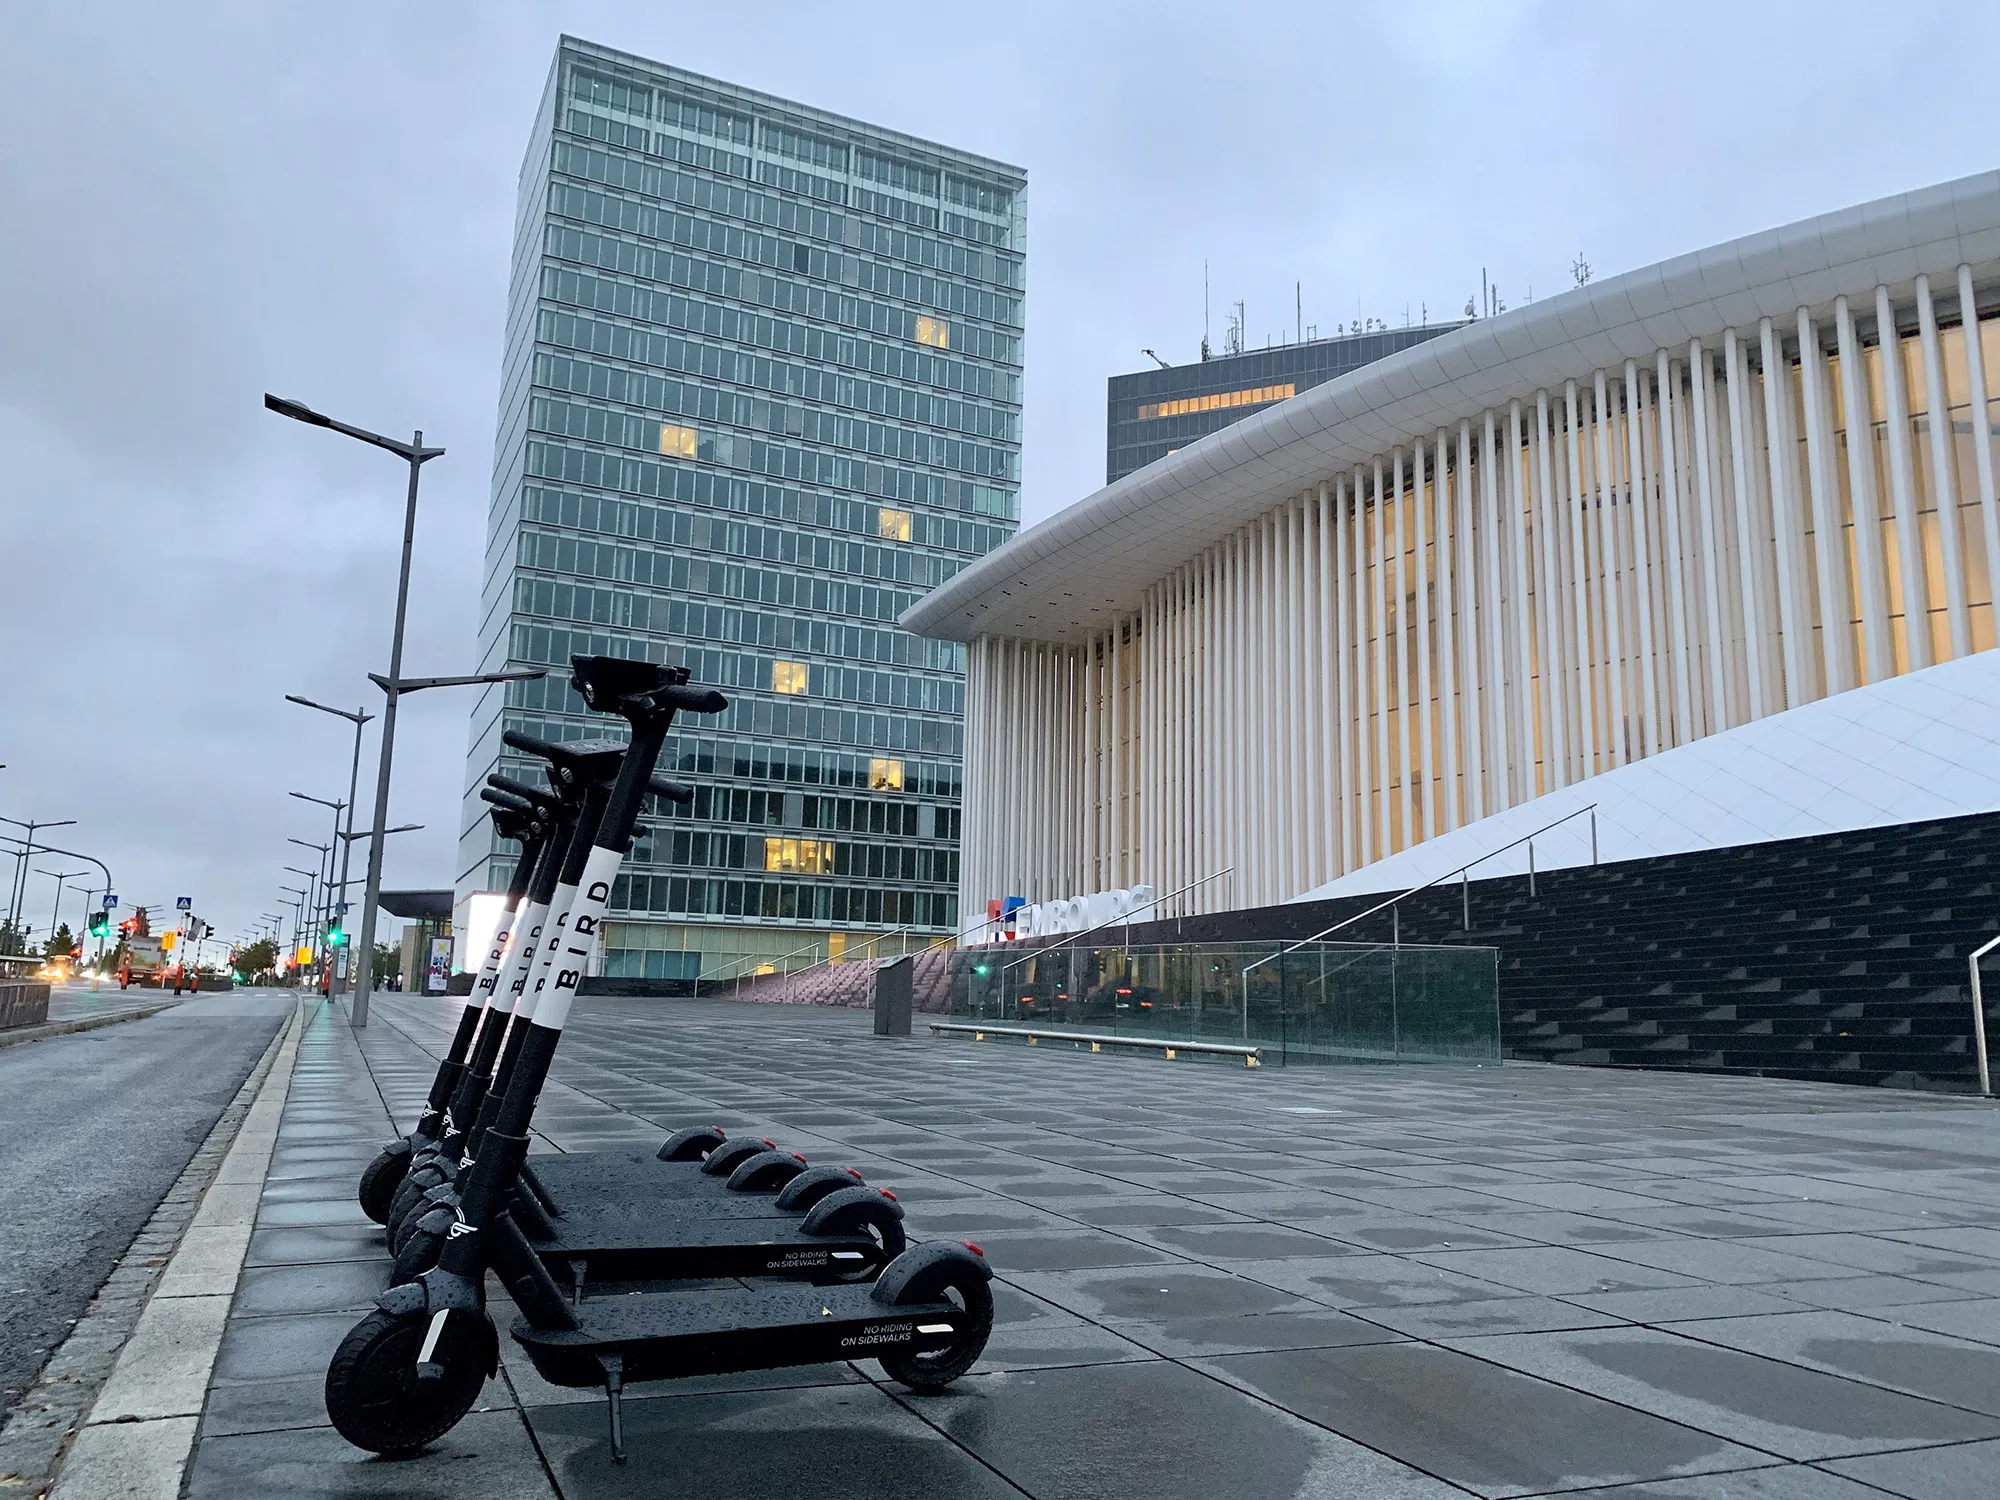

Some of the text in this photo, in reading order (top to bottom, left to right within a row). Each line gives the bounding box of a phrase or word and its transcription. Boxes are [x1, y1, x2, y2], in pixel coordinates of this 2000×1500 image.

[555, 881, 610, 990] BIRD
[478, 930, 509, 989] BIRD
[510, 925, 542, 993] BIRD
[785, 1250, 828, 1260] NO RIDING
[766, 1258, 828, 1269] ON SIDEWALKS
[863, 1322, 913, 1334] NO RIDING
[840, 1332, 912, 1346] ON SIDEWALKS
